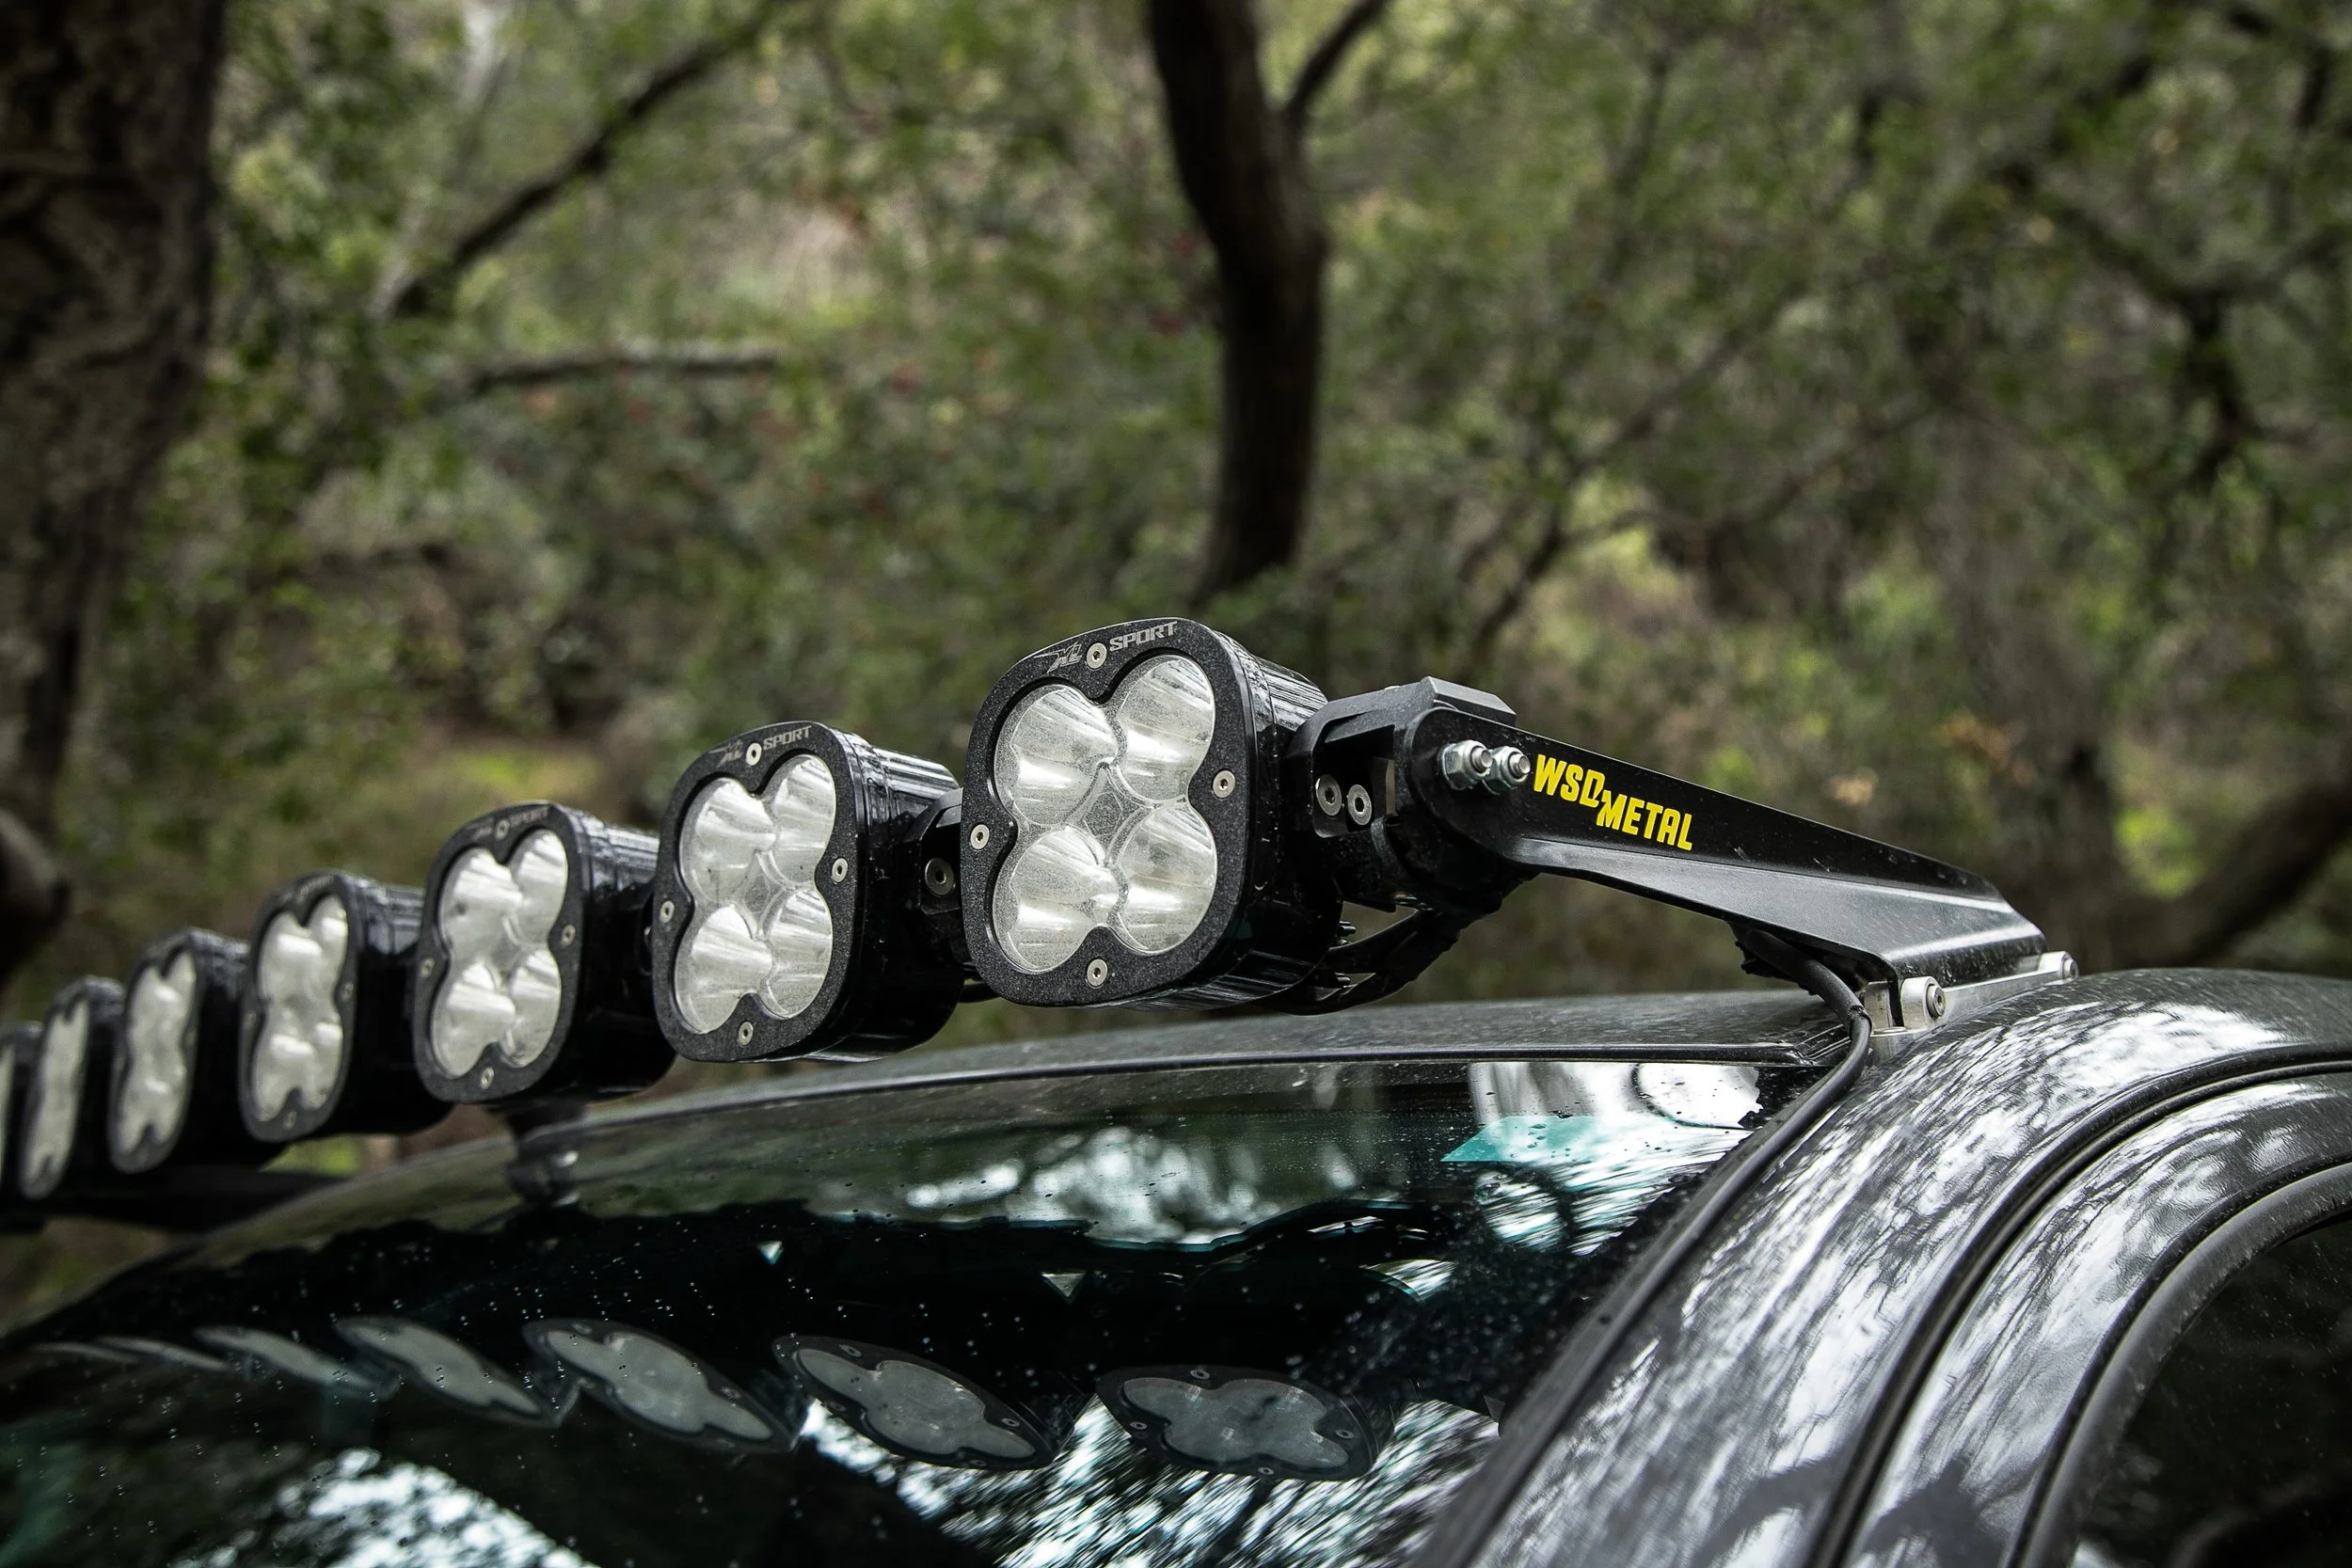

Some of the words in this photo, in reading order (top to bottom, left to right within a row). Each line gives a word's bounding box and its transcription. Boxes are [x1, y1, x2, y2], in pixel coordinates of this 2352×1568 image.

[1109, 621, 1178, 652] SPORT
[763, 725, 812, 751] SPORT
[1534, 753, 1605, 808] WSD
[1596, 789, 1692, 851] METAL
